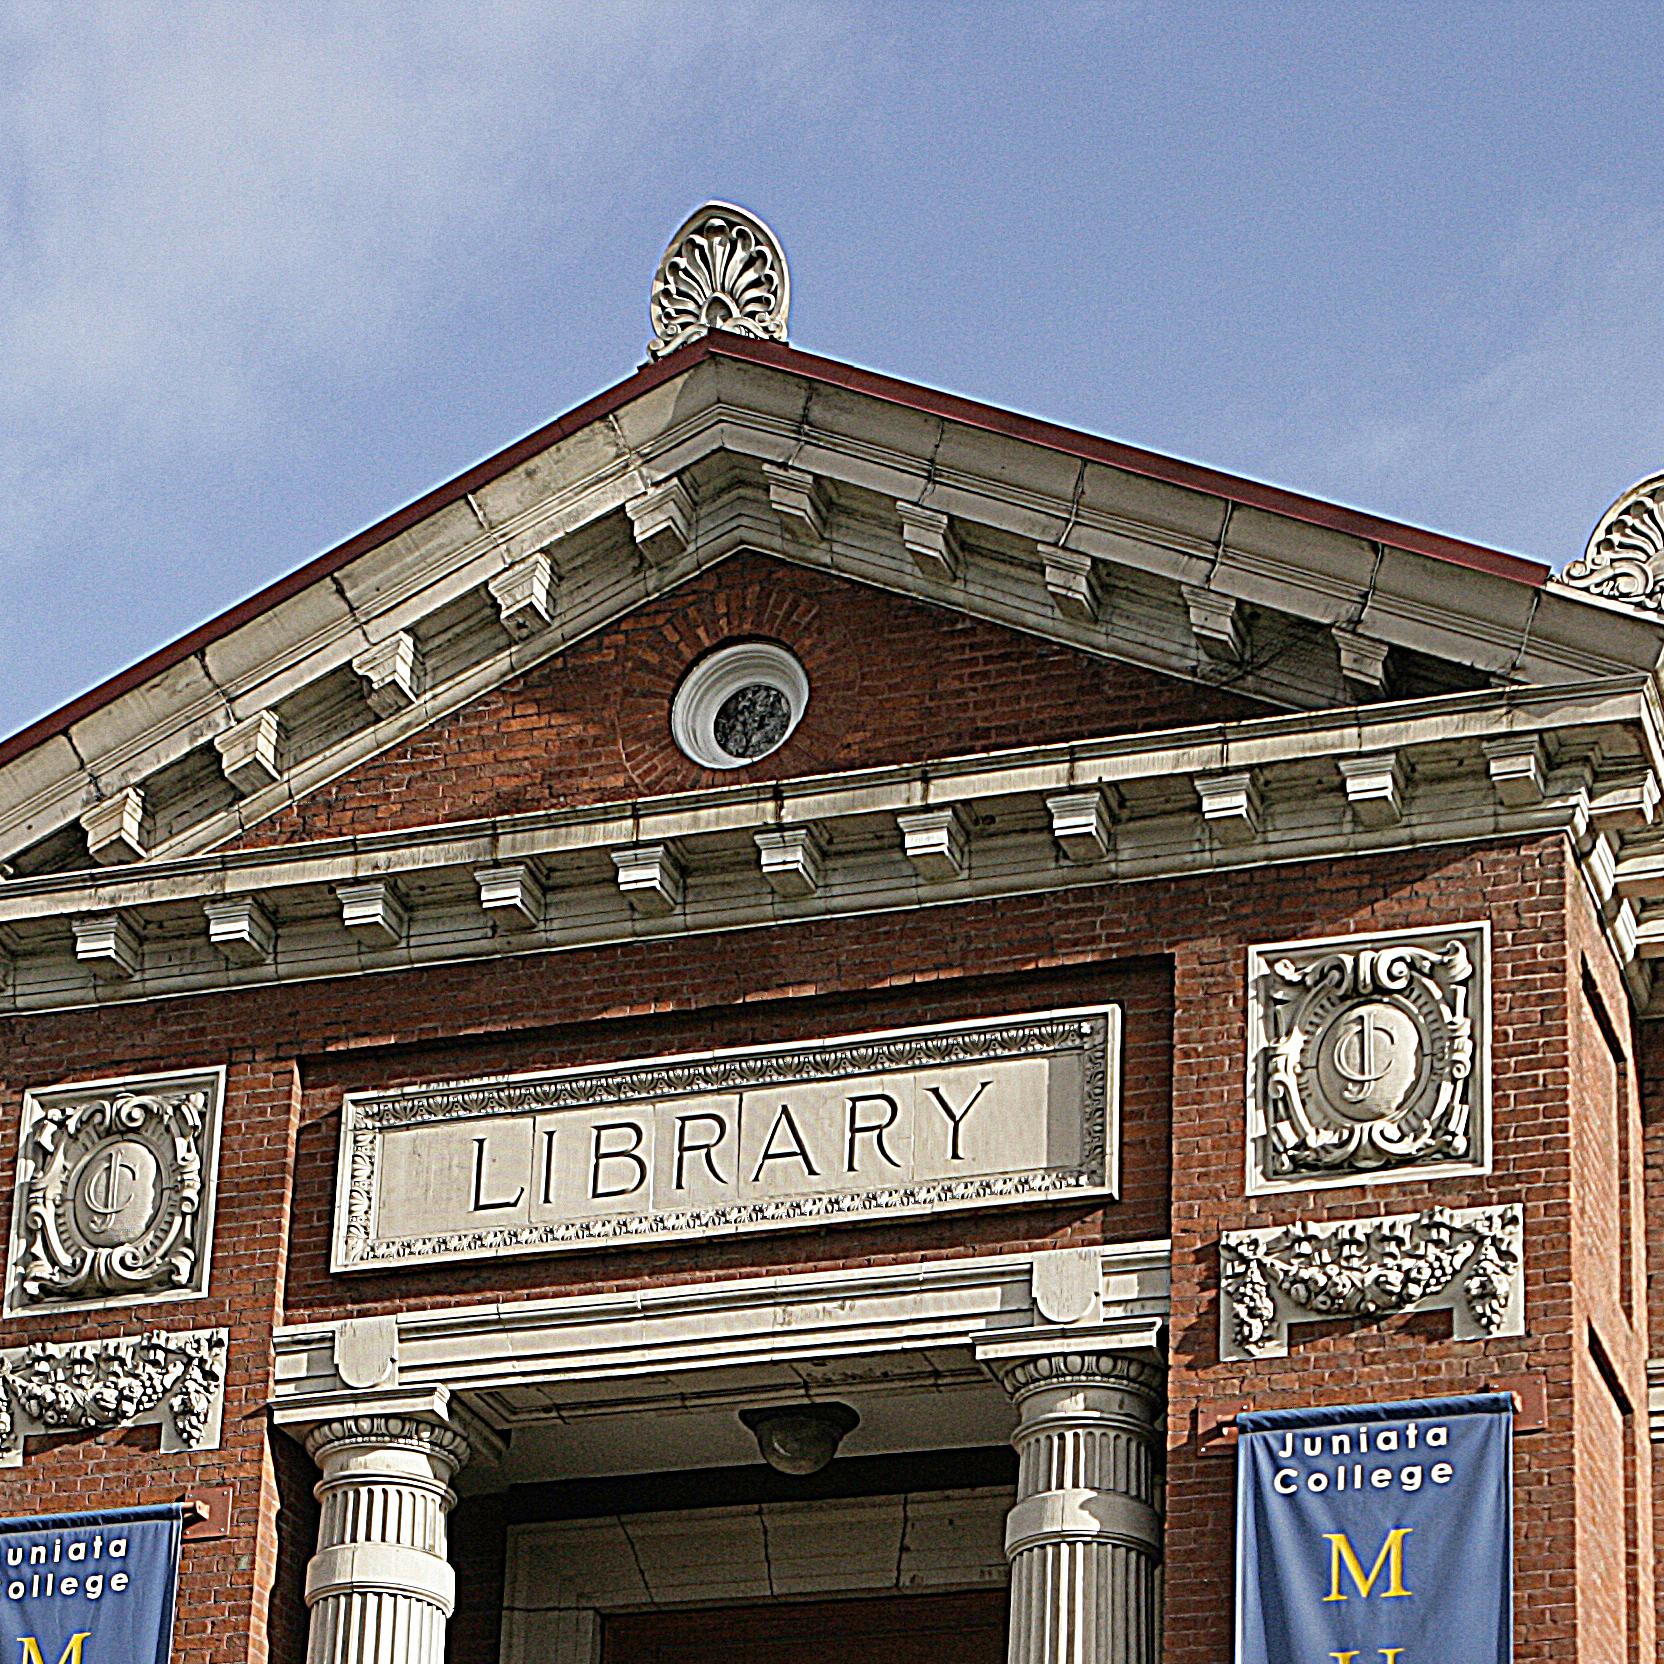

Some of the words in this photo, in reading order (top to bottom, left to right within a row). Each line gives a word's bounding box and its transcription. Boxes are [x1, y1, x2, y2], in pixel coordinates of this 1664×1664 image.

[468, 1079, 995, 1213] LIBRARY
[1277, 1421, 1449, 1459] Juniata
[1273, 1461, 1454, 1495] College
